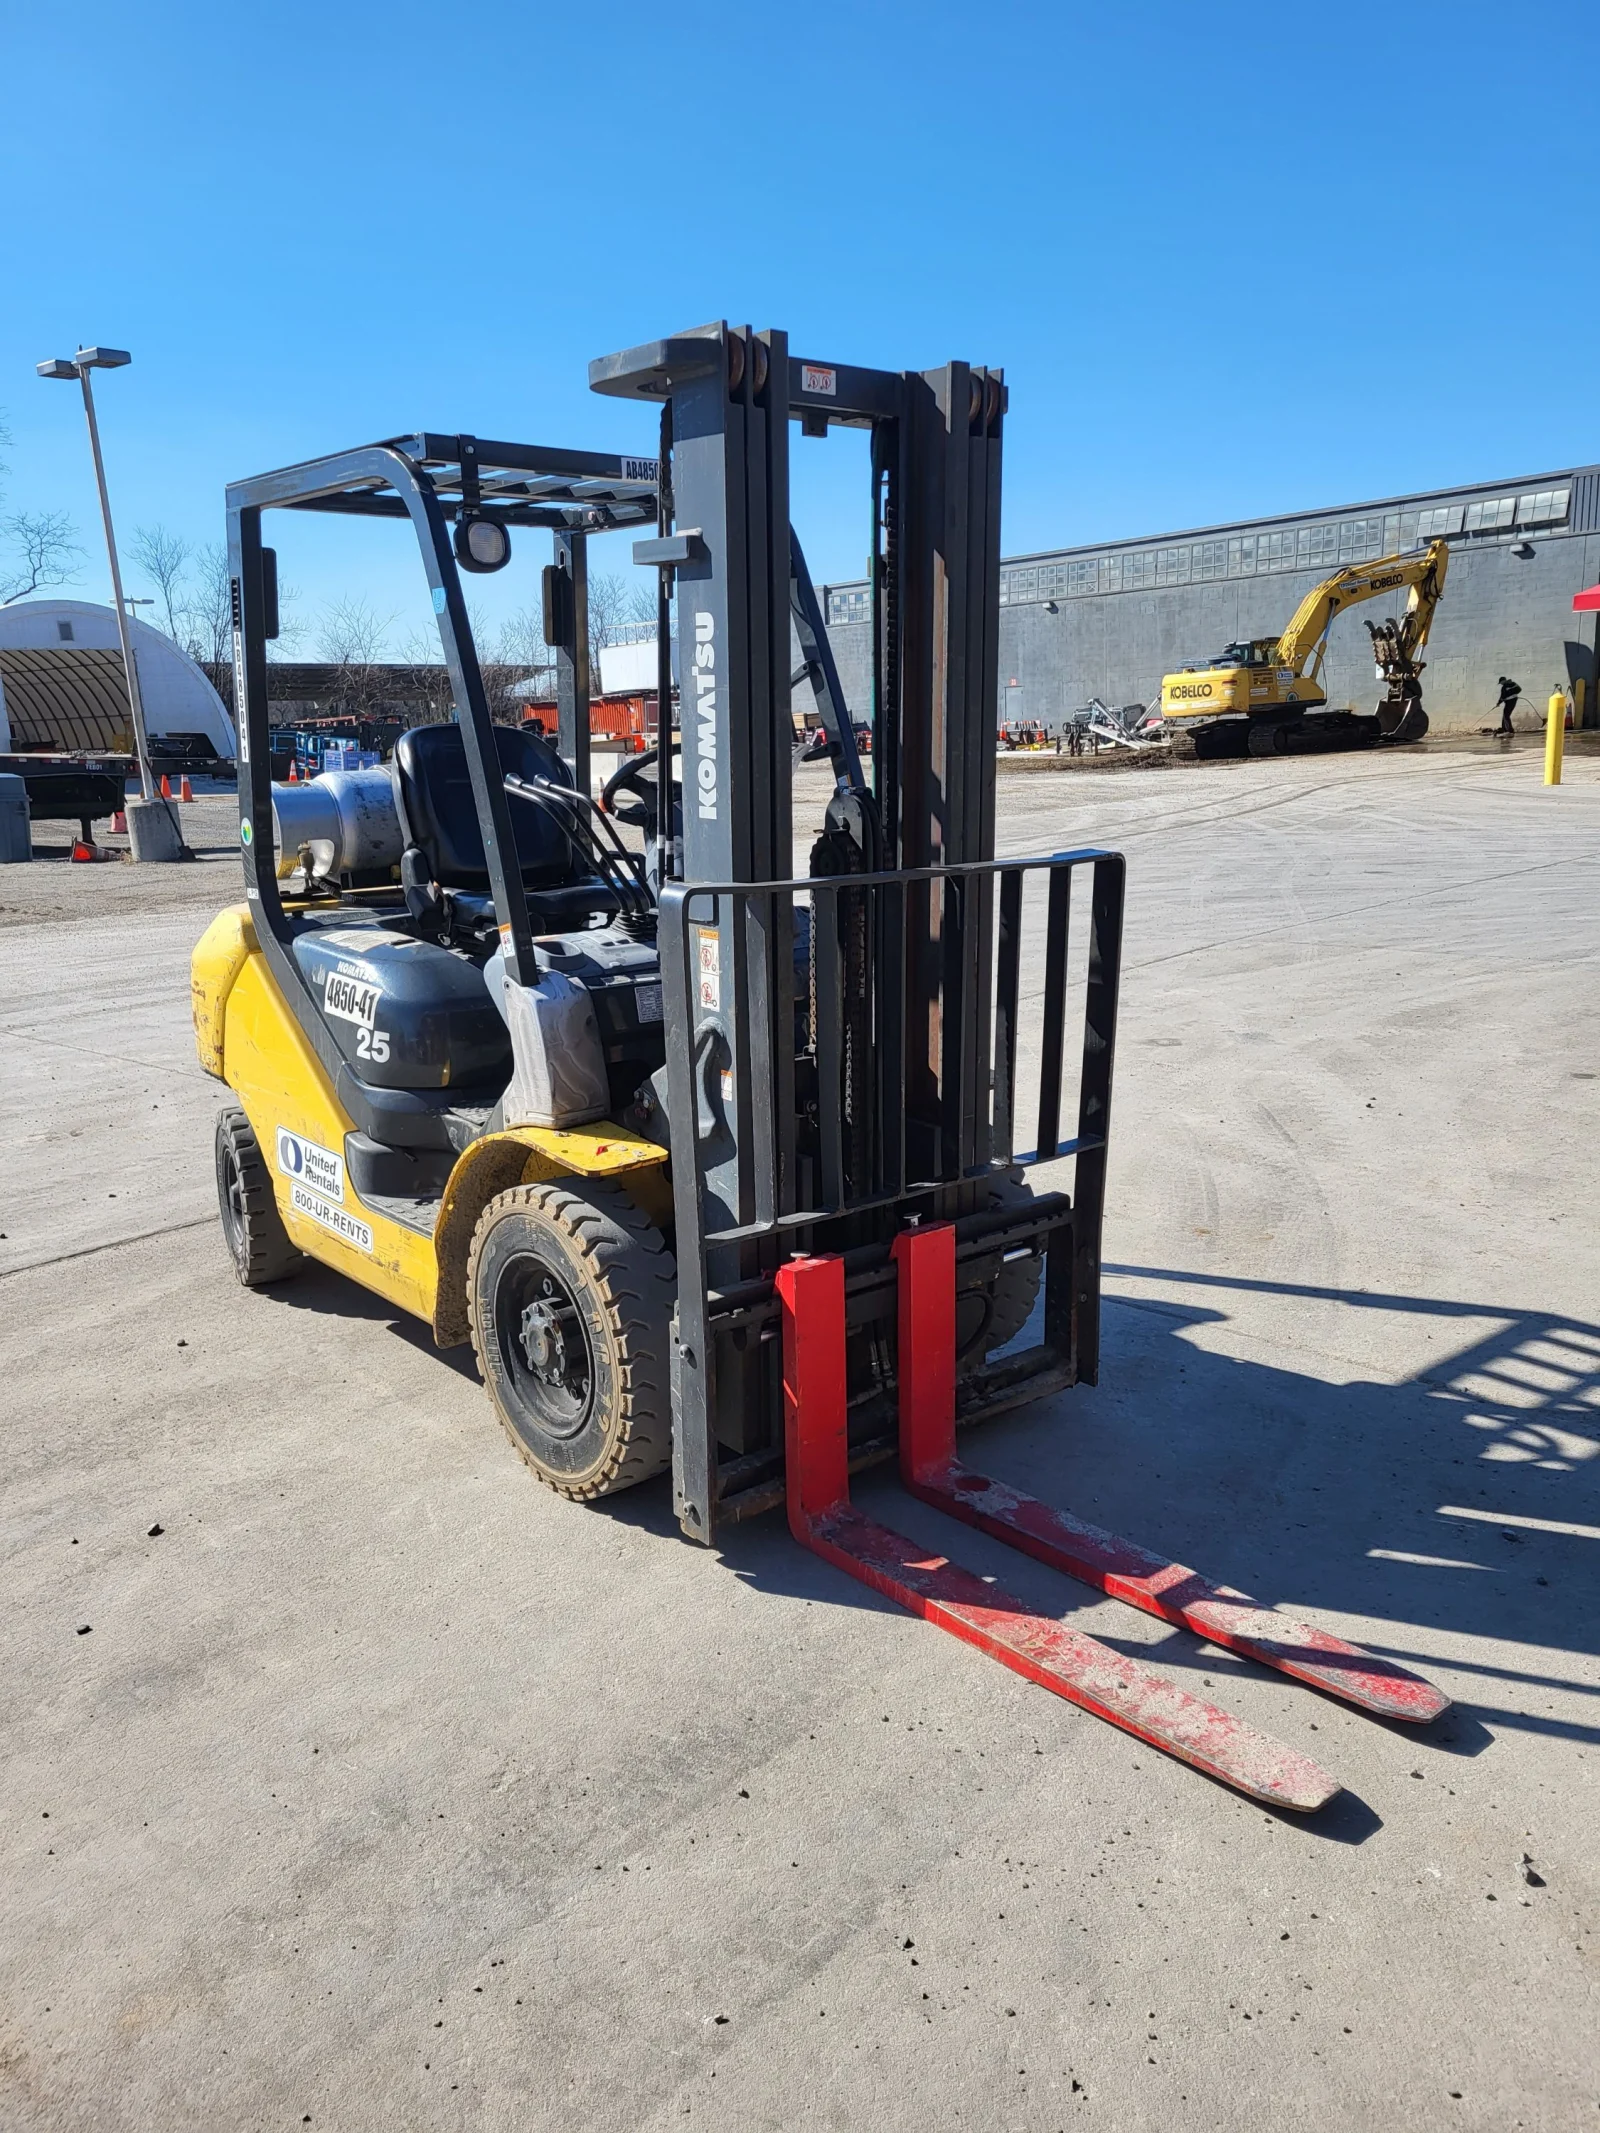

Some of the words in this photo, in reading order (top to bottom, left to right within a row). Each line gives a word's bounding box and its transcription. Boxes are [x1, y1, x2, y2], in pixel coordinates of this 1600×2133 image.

[1371, 574, 1404, 591] KOBELCO
[235, 633, 247, 759] AB485041
[1170, 684, 1213, 699] KOBELCO
[692, 611, 718, 820] KOMATSU
[327, 977, 377, 1021] 4850-41
[356, 1027, 391, 1063] 25
[304, 1146, 337, 1177] United
[305, 1164, 341, 1197] Rentals
[294, 1190, 369, 1245] 800-UR-RENTS
